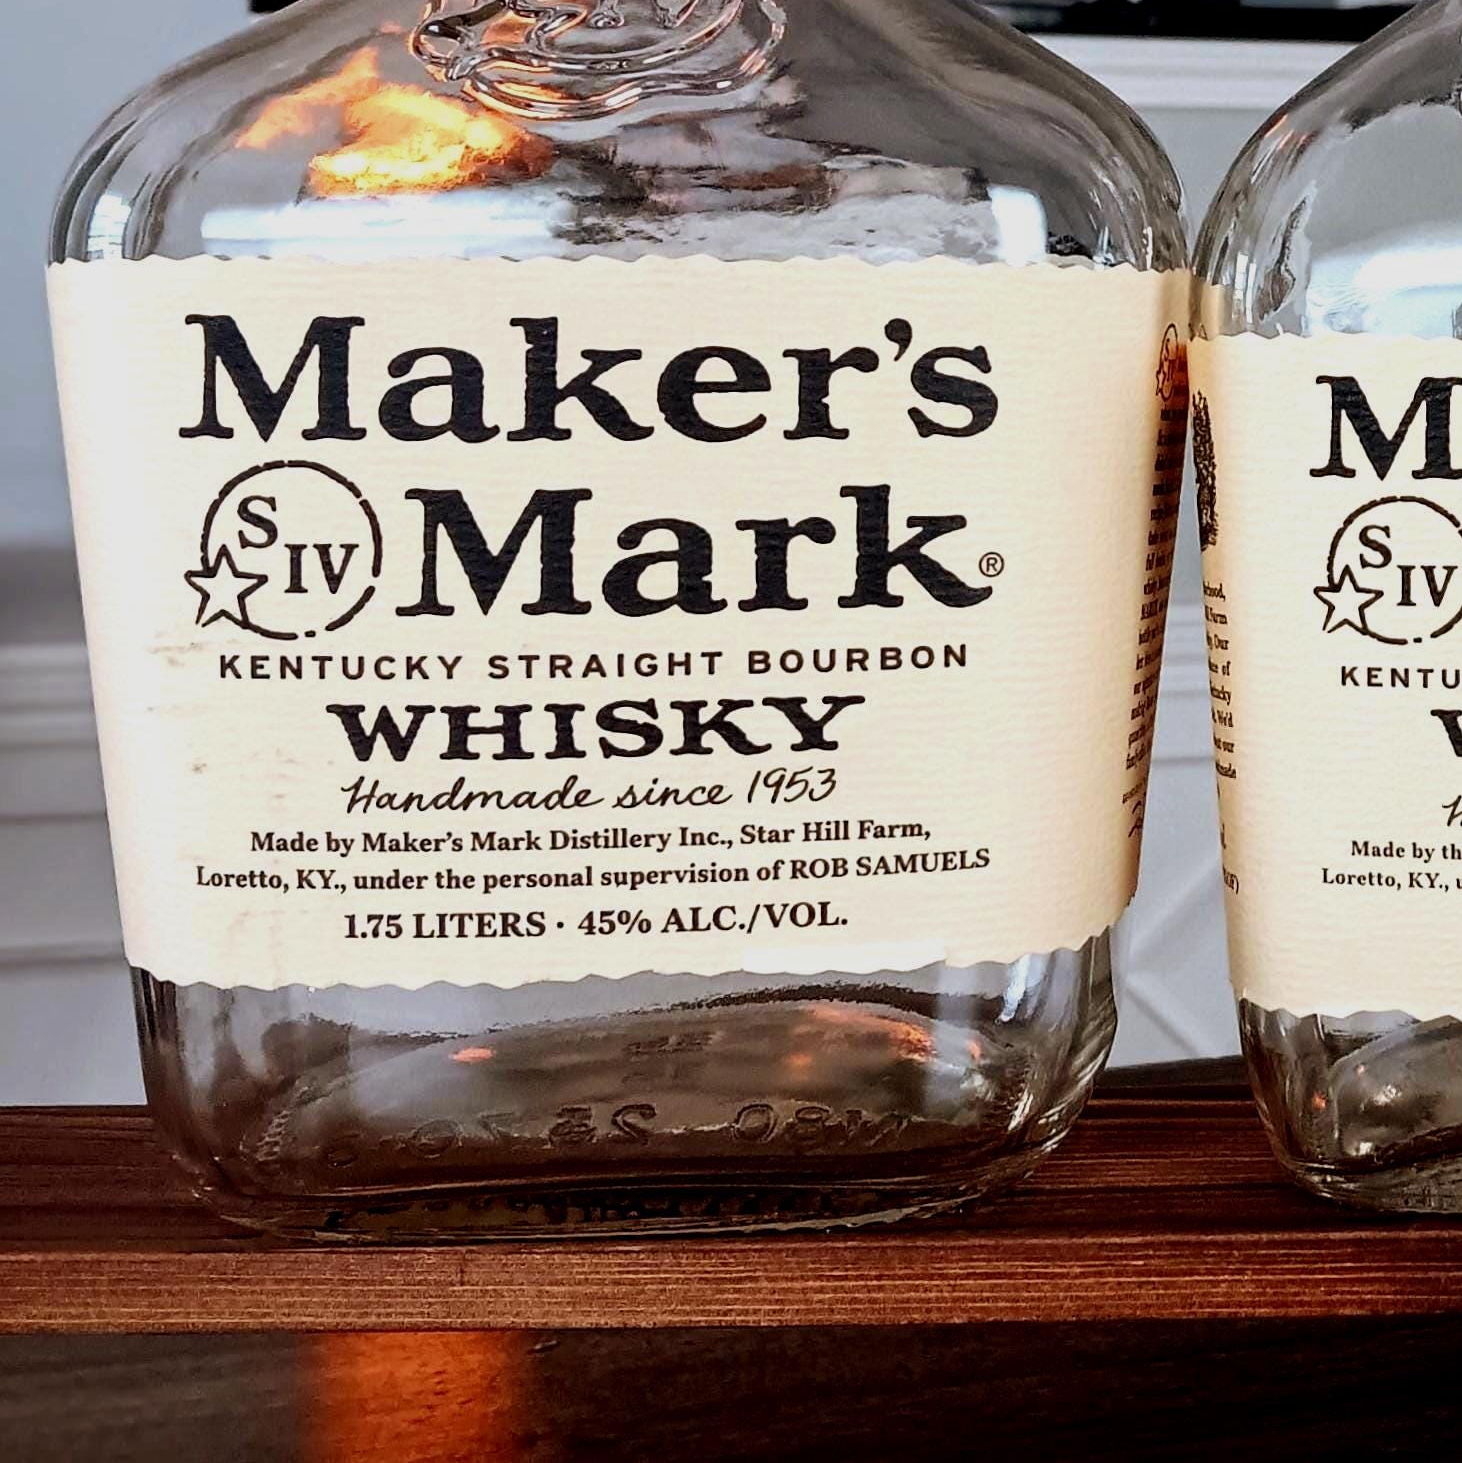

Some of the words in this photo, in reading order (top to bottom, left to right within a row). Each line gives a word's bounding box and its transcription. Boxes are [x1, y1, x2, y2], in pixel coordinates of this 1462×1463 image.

[178, 313, 999, 444] Maker's
[219, 654, 463, 681] KENTUCKY
[487, 650, 724, 680] STRAIGHT
[747, 643, 967, 675] BOURBON
[325, 695, 866, 763] WHISKY
[341, 774, 603, 816] Handmade
[612, 776, 733, 811] since
[747, 766, 837, 804] 1953
[250, 830, 319, 853] Made
[324, 831, 356, 858] by
[361, 831, 464, 853] Maker's
[470, 829, 543, 852] Mark
[549, 827, 672, 854] Distillery
[678, 826, 734, 850] Inc.,
[739, 824, 796, 845] Star
[801, 819, 851, 843] Hill
[857, 819, 932, 841] Farm,
[1351, 839, 1406, 859] Made
[1411, 841, 1436, 864] by
[196, 865, 290, 894] Loretto,
[295, 868, 347, 895] KY.,
[352, 868, 429, 890] under
[434, 868, 476, 890] the
[482, 865, 593, 895] personal
[600, 861, 750, 891] supervision
[756, 858, 786, 882] of
[789, 857, 849, 880] ROB
[855, 847, 991, 877] SAMUELS
[1321, 867, 1402, 891] Loretto,
[1408, 871, 1450, 893] KY.,
[343, 913, 404, 940] 1.75
[412, 911, 547, 939] LITERS
[577, 909, 652, 936] 45%
[660, 900, 849, 935] ALC./VOL.
